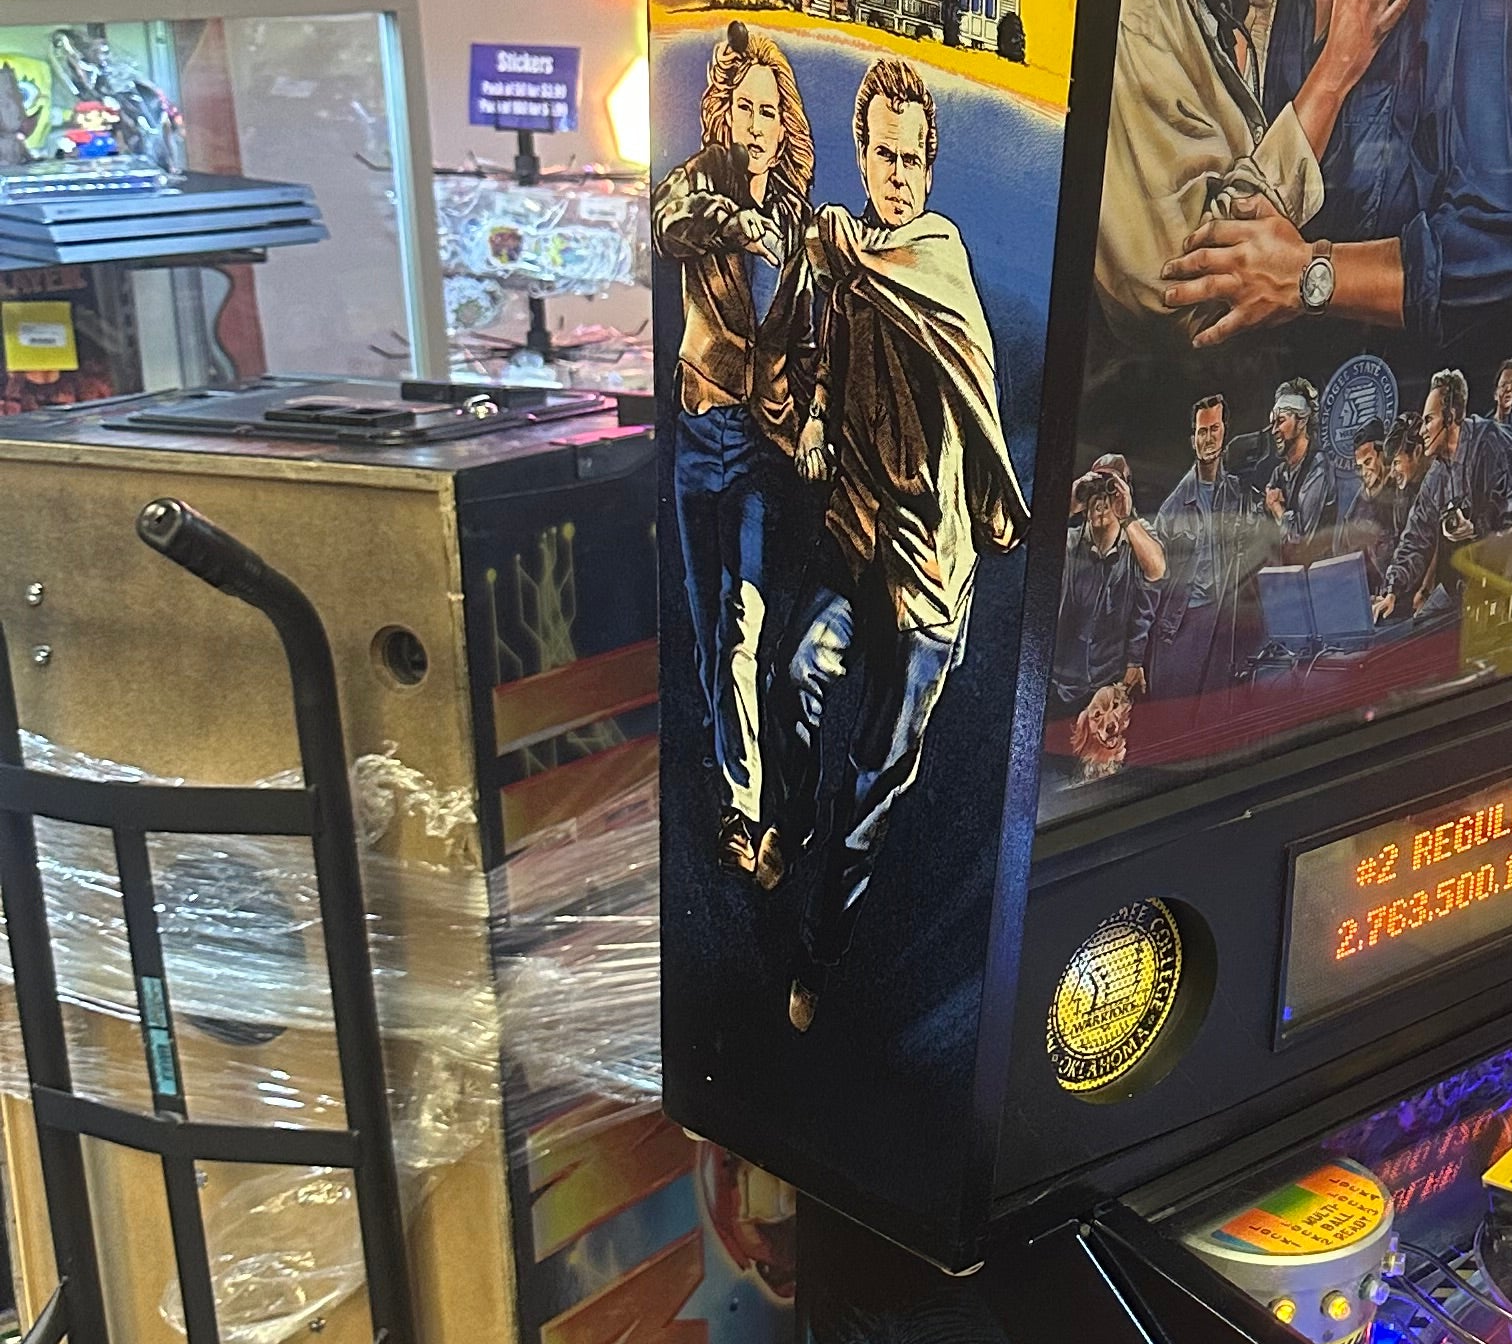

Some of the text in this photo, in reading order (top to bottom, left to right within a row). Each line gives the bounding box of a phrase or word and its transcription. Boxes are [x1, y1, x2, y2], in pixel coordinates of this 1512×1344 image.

[496, 49, 554, 75] Stickers
[1353, 361, 1381, 377] STATE
[1356, 843, 1399, 887] #2
[1151, 917, 1174, 1012] COLLEGE
[1058, 1026, 1150, 1078] OKLAHOMA
[1320, 1212, 1355, 1232] BALL
[1333, 1216, 1374, 1241] READY
